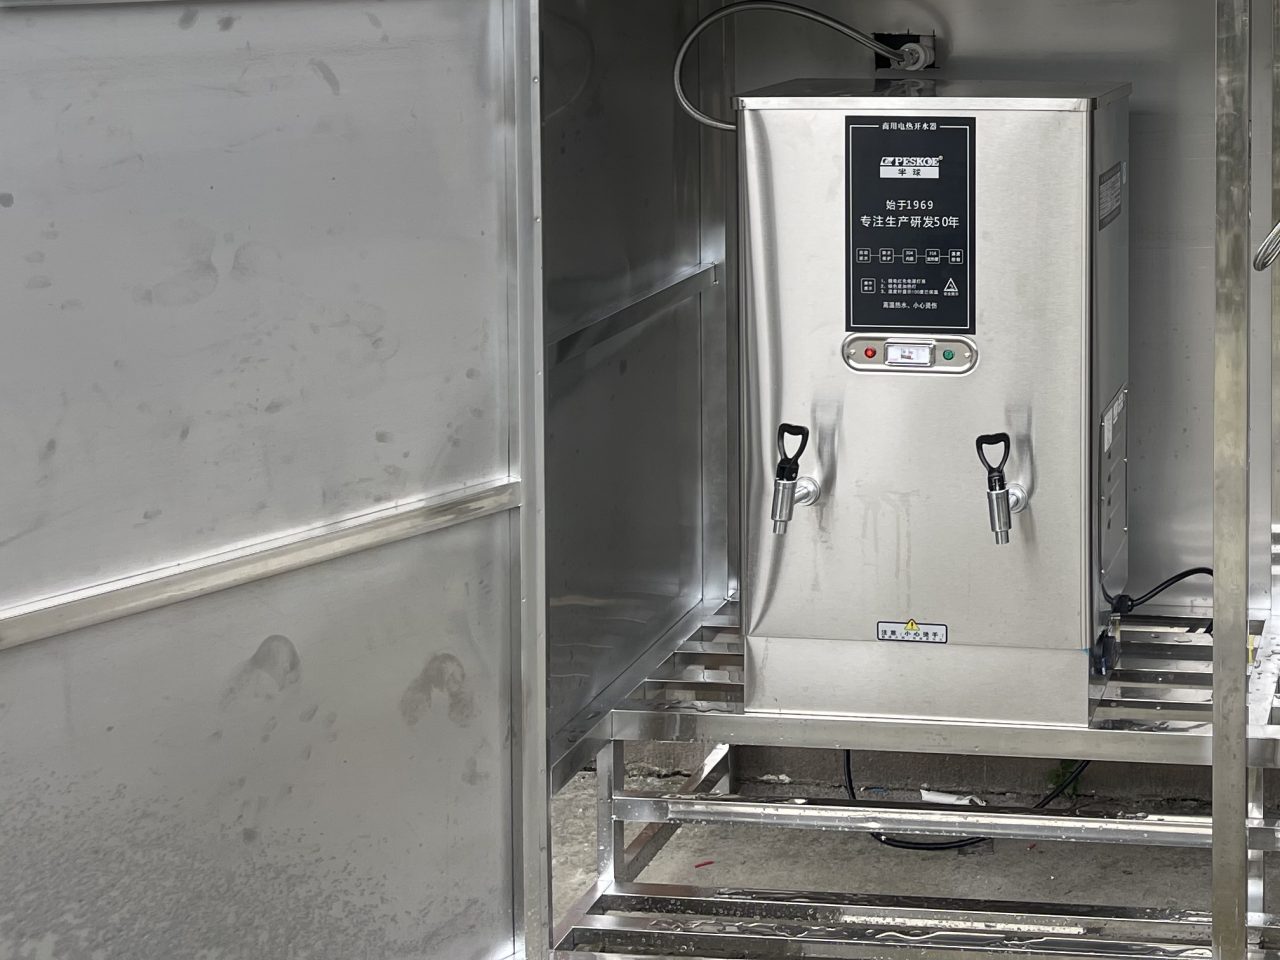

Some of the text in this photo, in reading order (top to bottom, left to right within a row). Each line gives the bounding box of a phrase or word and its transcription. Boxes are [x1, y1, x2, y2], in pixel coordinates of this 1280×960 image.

[886, 200, 934, 211] 始于1969
[860, 215, 960, 228] 专注生产研发50年
